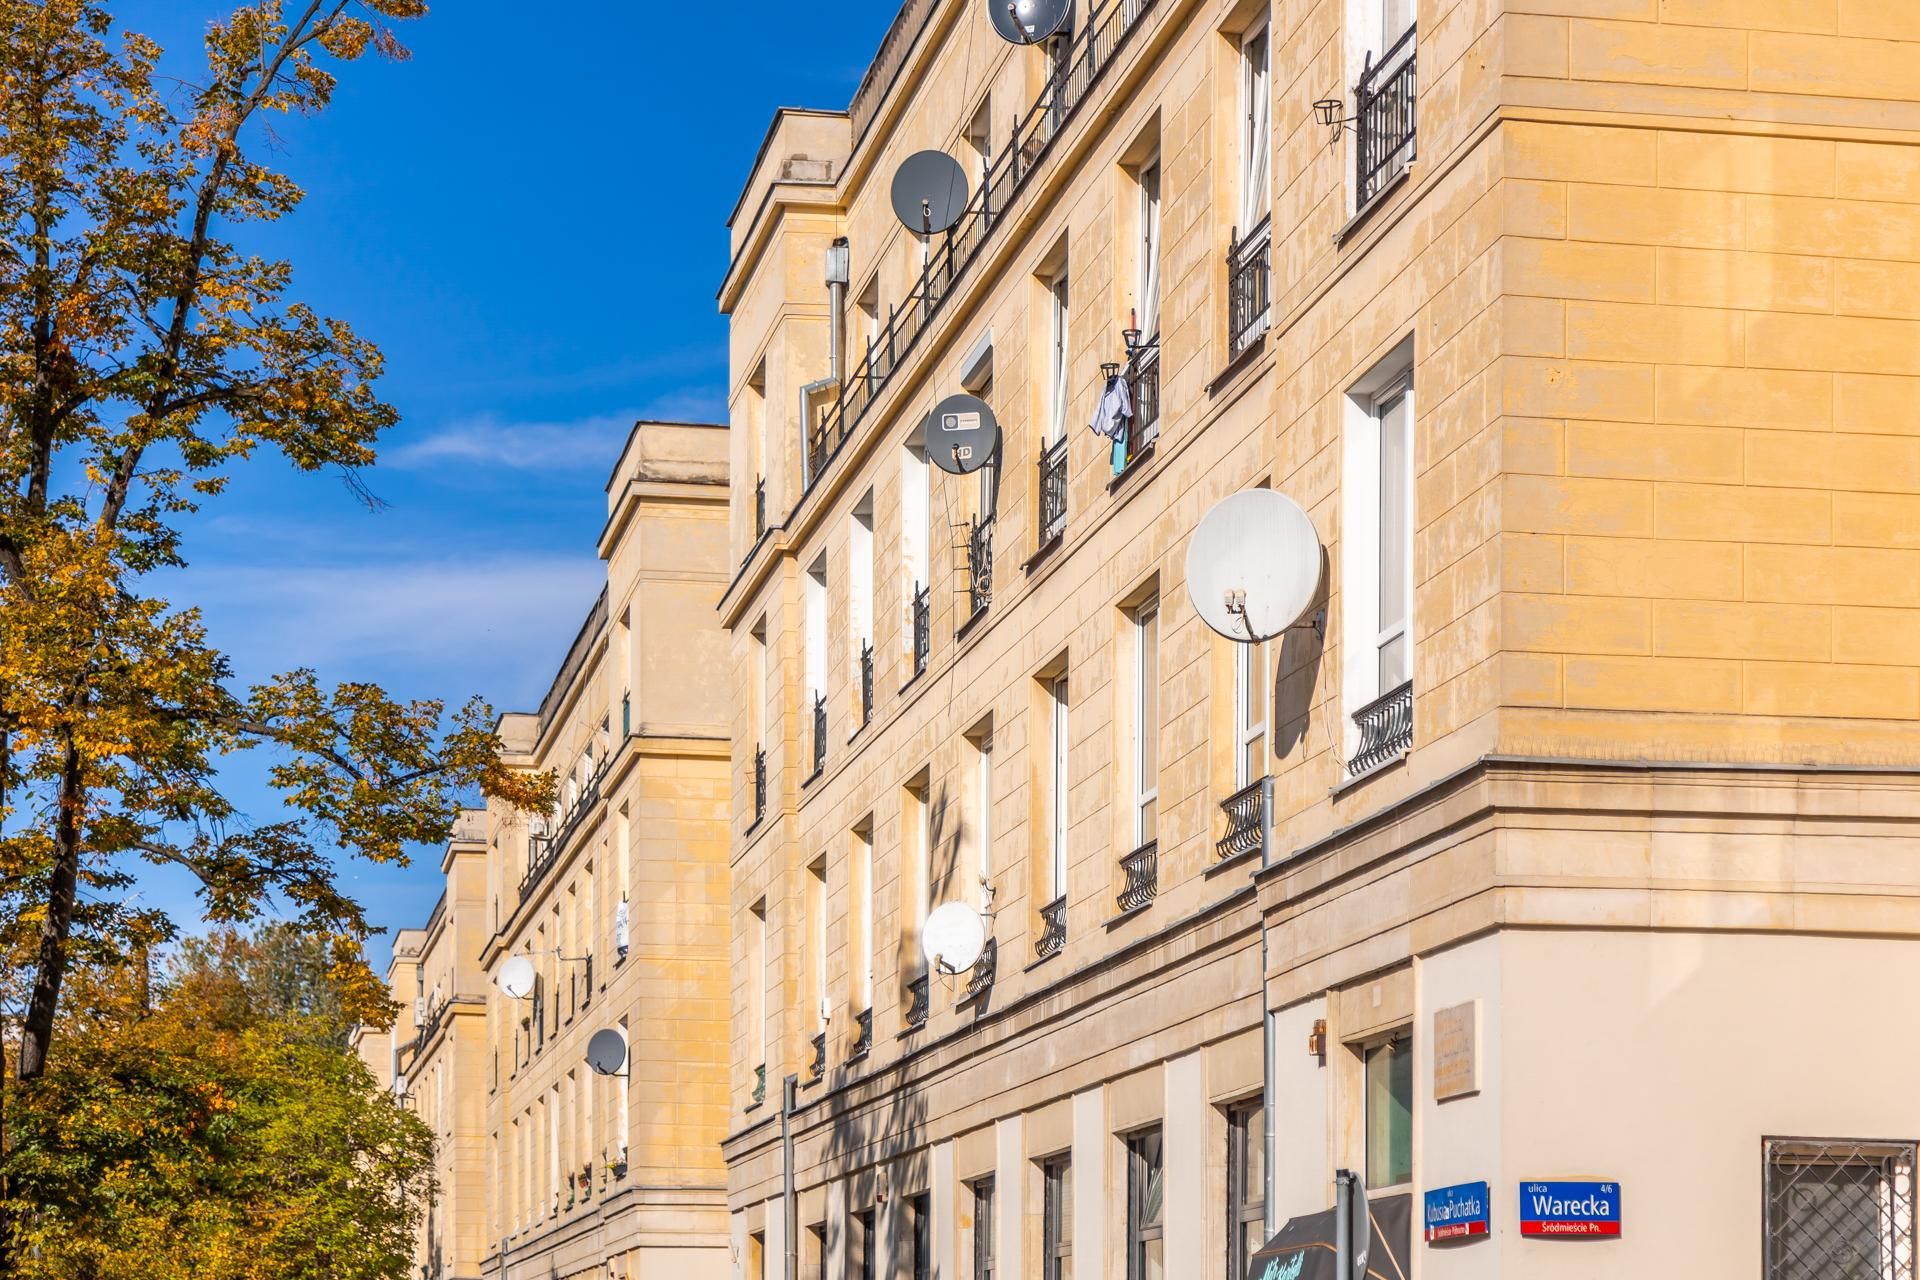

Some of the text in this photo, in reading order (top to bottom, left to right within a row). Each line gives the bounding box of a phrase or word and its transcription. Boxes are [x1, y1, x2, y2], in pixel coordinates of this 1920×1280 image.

[1528, 1183, 1548, 1193] ulica
[1600, 1184, 1613, 1194] 4/6
[1449, 1195, 1481, 1219] Puchatka
[1532, 1194, 1610, 1216] Warecka
[1542, 1221, 1602, 1233] Śródmieście Pn.
